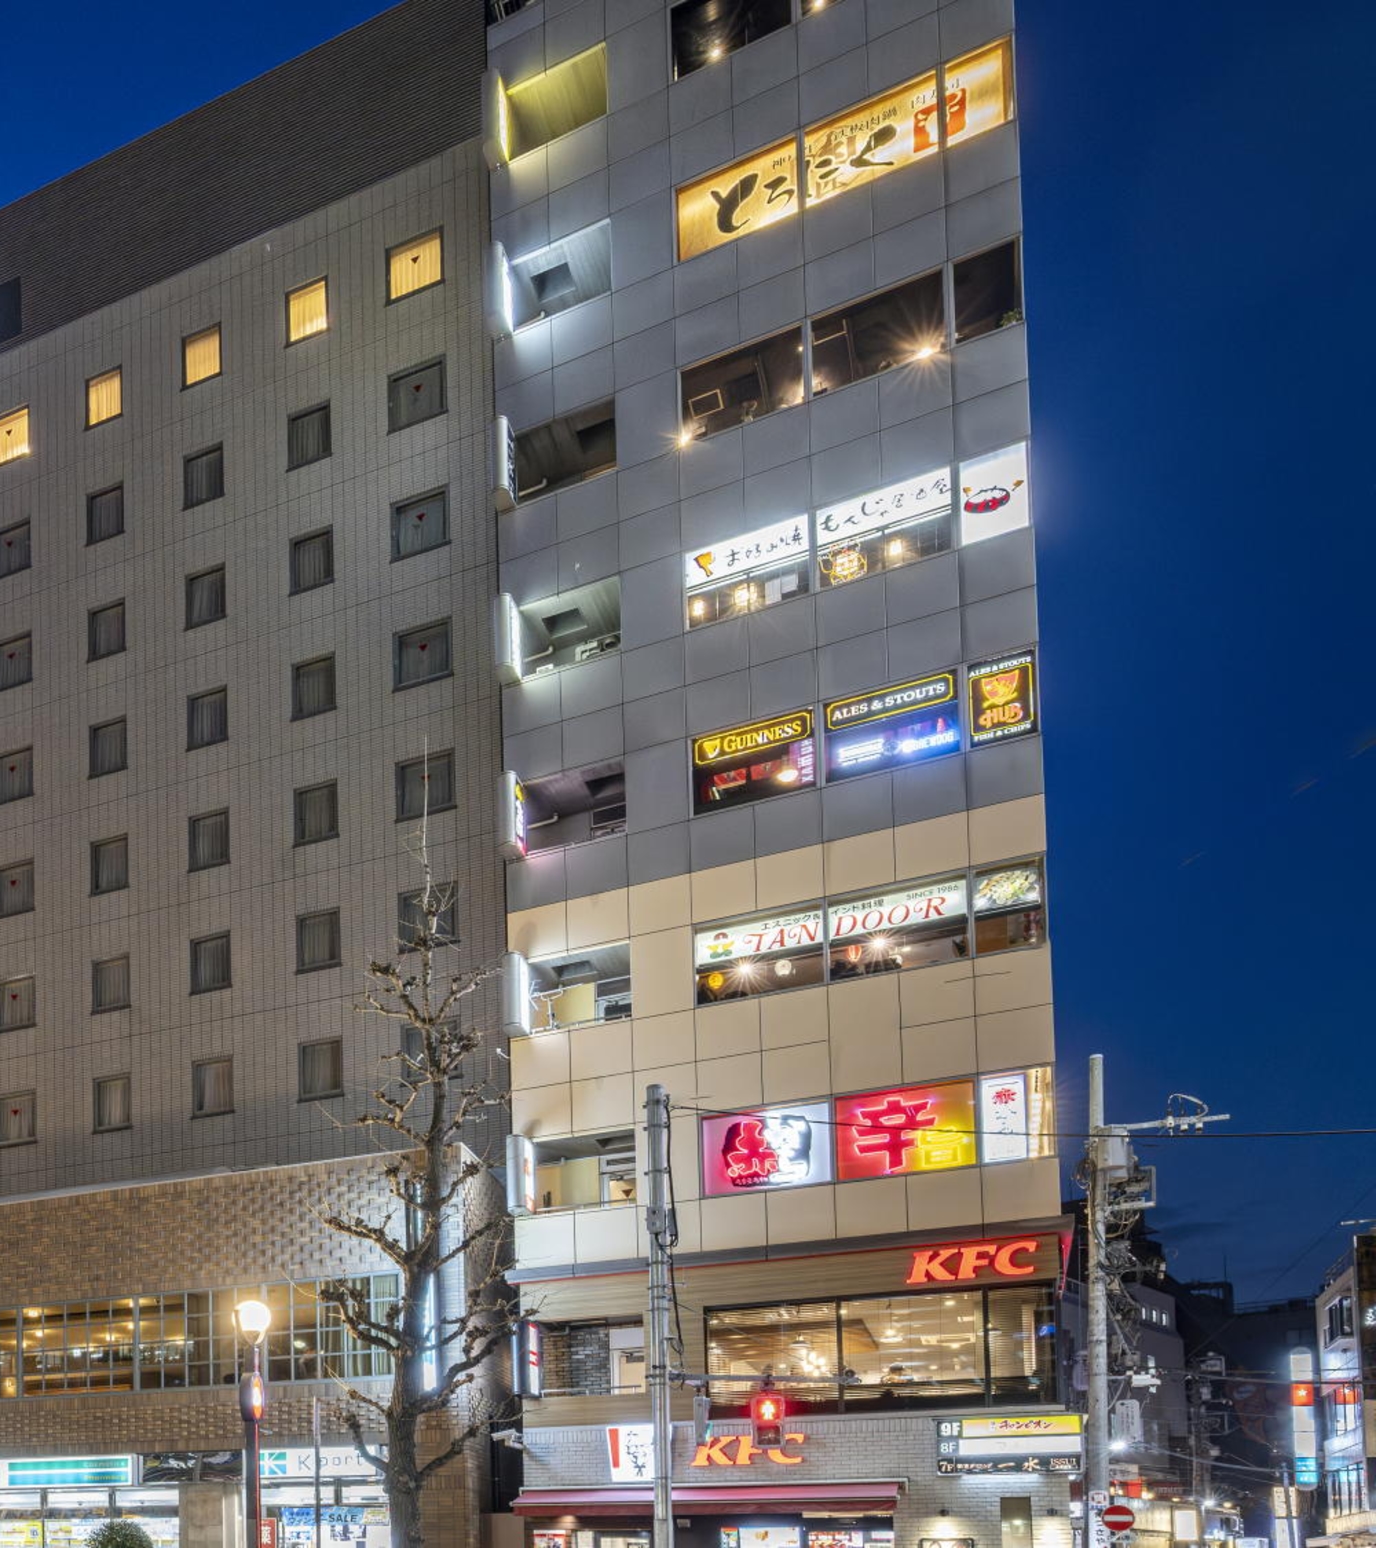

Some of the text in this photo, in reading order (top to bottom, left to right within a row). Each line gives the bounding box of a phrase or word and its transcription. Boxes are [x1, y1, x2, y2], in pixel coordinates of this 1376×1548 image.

[832, 682, 945, 721] ALES & STOUTS
[979, 702, 1024, 728] HUB
[724, 720, 802, 752] GUINNESS
[906, 889, 934, 900] SINCE
[906, 1241, 1038, 1285] KFC
[940, 1422, 961, 1436] 9F
[690, 1433, 806, 1467] KFC
[940, 1442, 958, 1453] 8F
[298, 1454, 311, 1471] K
[939, 1461, 955, 1472] 7F
